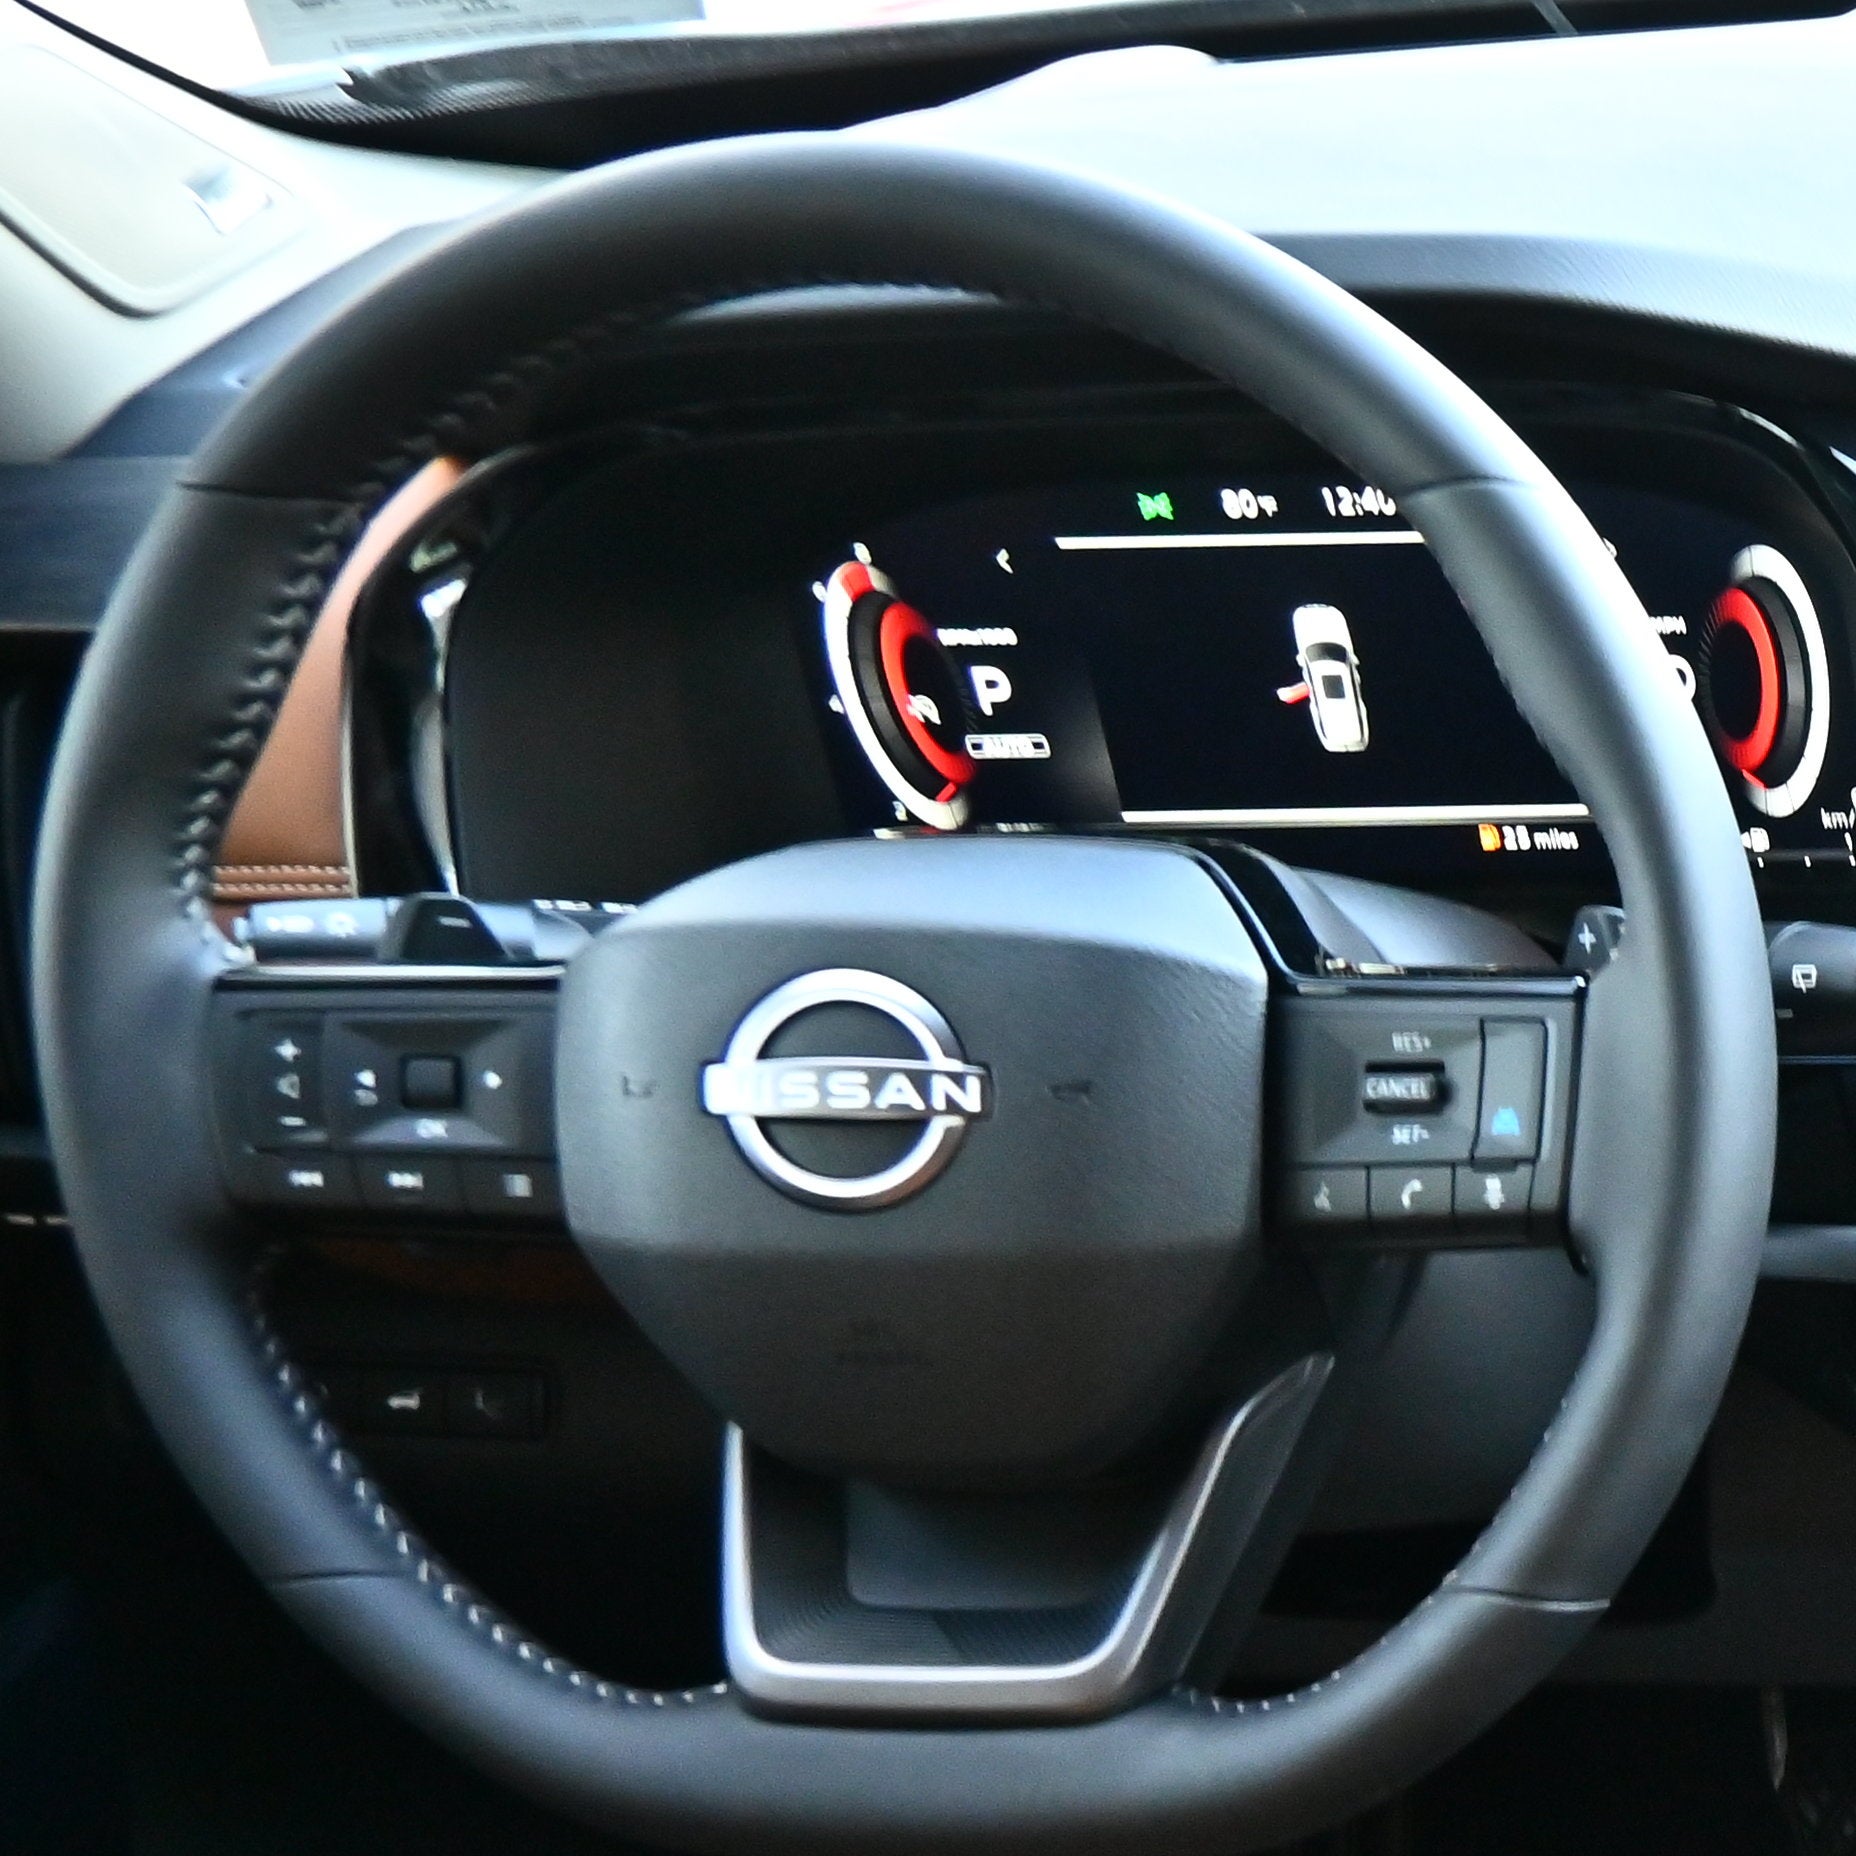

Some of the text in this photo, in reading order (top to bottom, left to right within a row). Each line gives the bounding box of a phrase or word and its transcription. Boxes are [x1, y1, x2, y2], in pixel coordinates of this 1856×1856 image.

[970, 665, 1012, 717] P
[1533, 827, 1580, 850] miles
[1365, 1076, 1432, 1100] CANCEL
